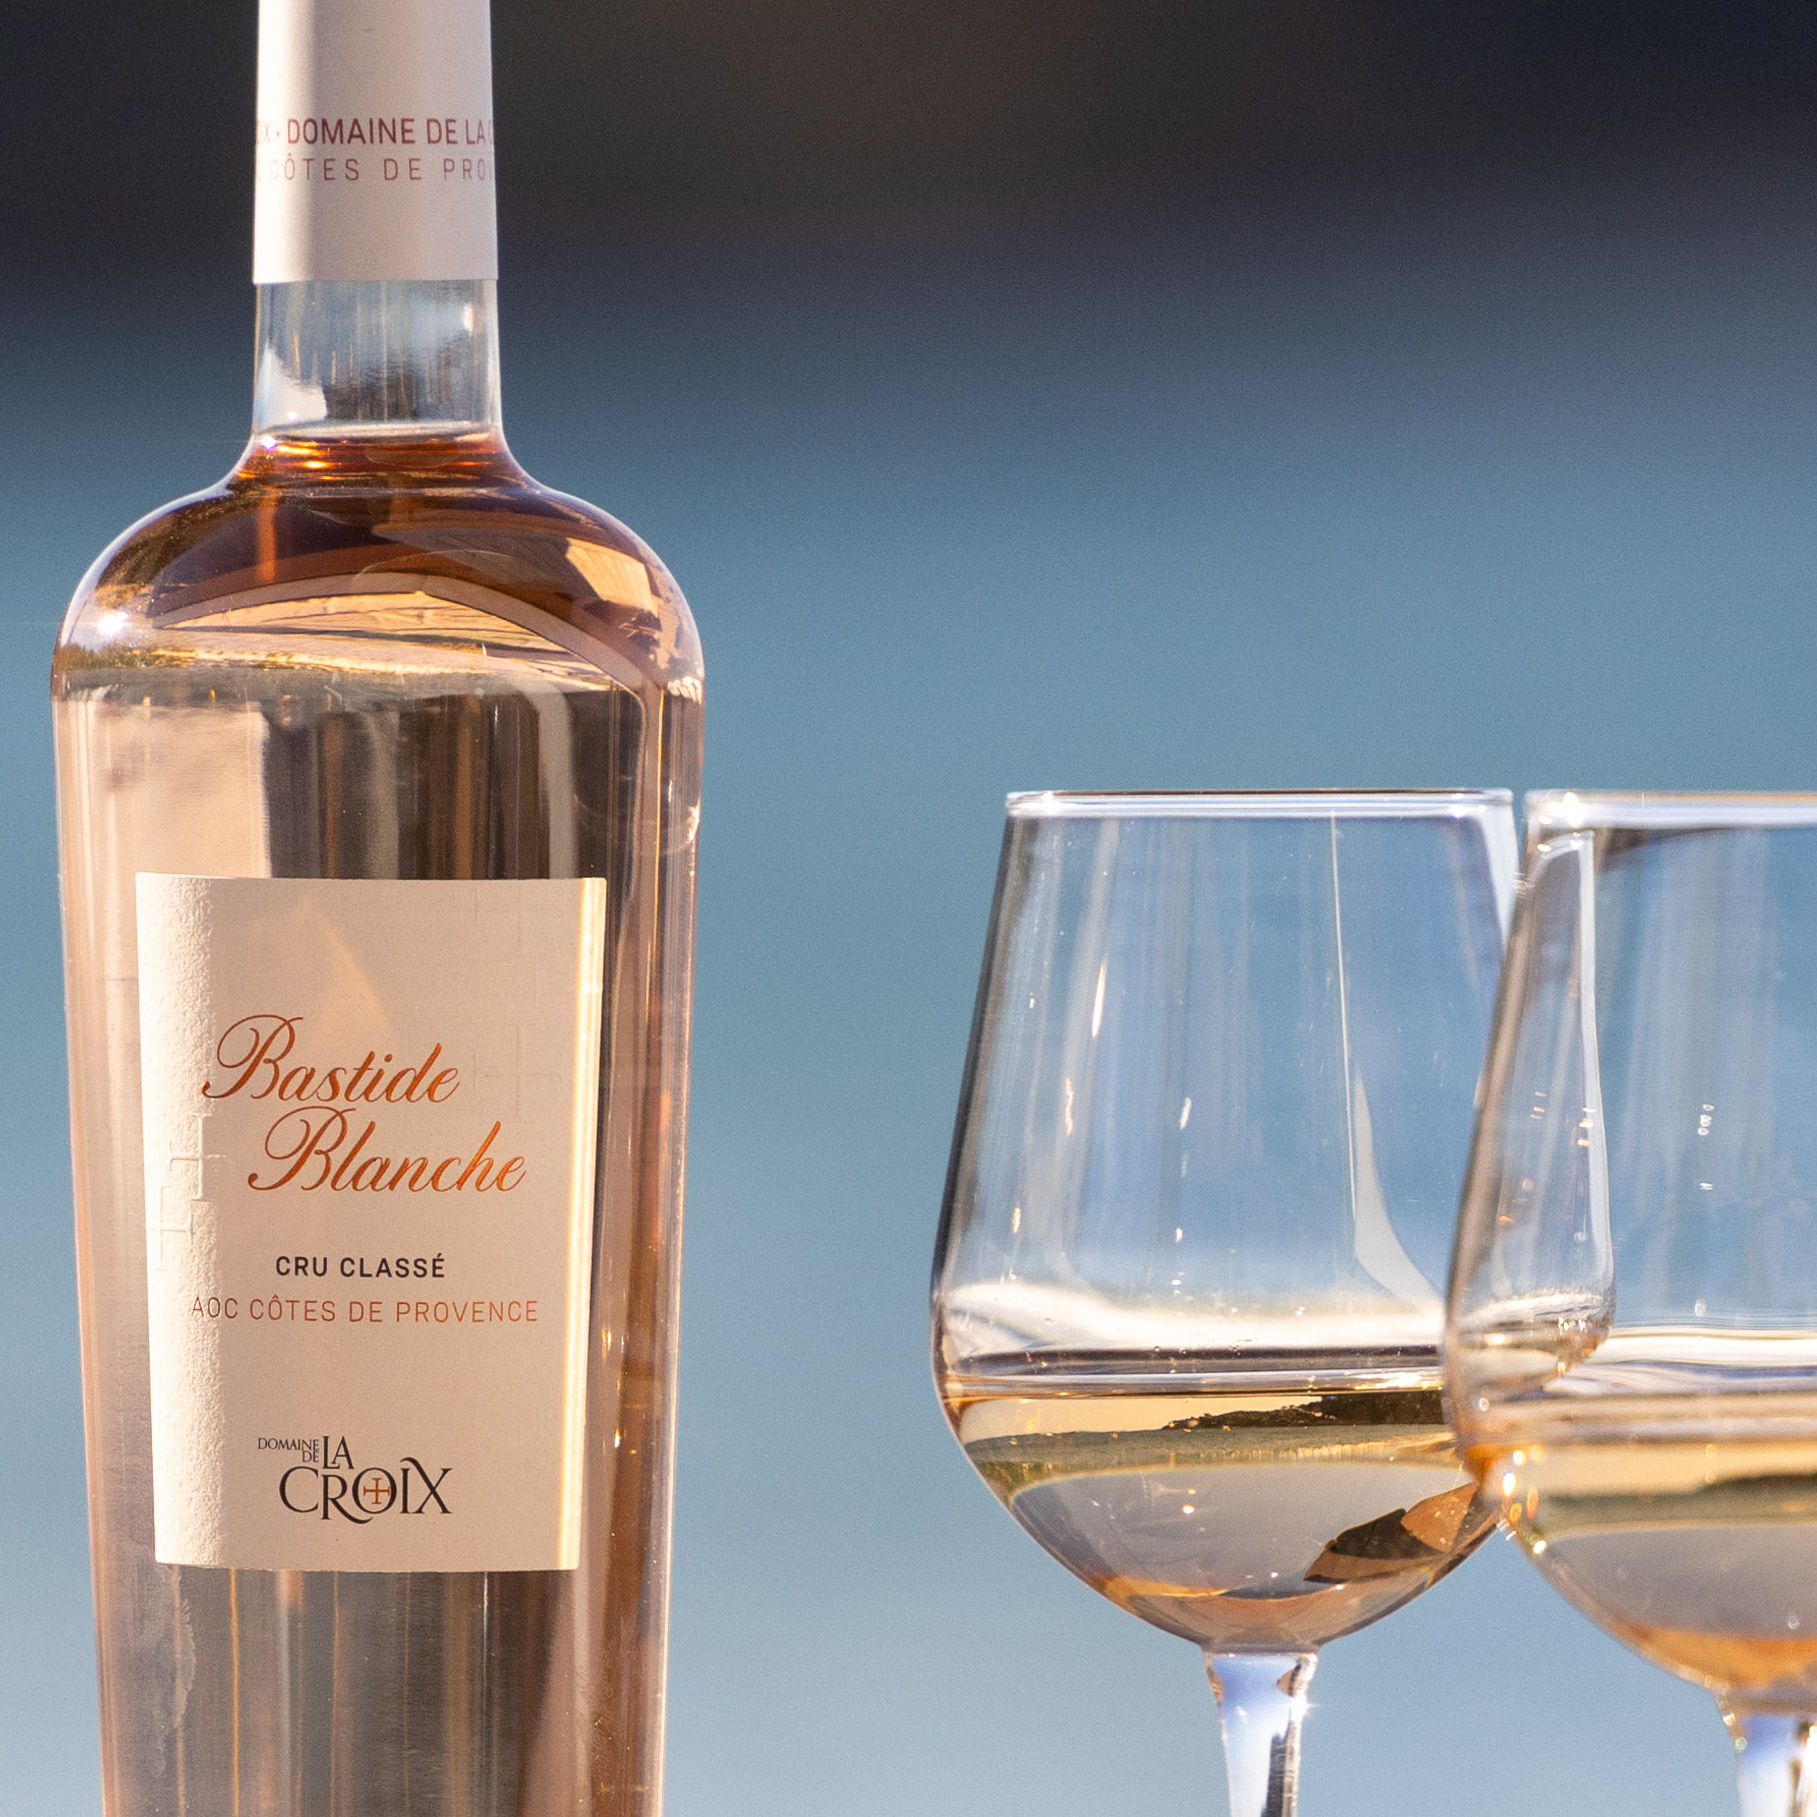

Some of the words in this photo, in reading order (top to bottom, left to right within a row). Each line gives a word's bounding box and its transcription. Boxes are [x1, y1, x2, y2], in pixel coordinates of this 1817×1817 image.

[287, 117, 415, 145] DOMAINE
[426, 118, 459, 145] DE
[465, 118, 487, 145] LA
[383, 158, 422, 181] DE
[200, 1014, 461, 1104] Bastide
[247, 1105, 528, 1193] Blanche
[275, 1255, 329, 1278] CRU
[339, 1252, 446, 1279] CLASSÉ
[190, 1296, 239, 1320] AOC
[248, 1293, 337, 1322] CÔTES
[348, 1300, 384, 1323] DE
[395, 1299, 539, 1323] PROVENCE
[257, 1436, 320, 1451] DOMAINE
[301, 1449, 320, 1463] DE
[321, 1435, 355, 1470] LA
[278, 1456, 454, 1525] CROIX
